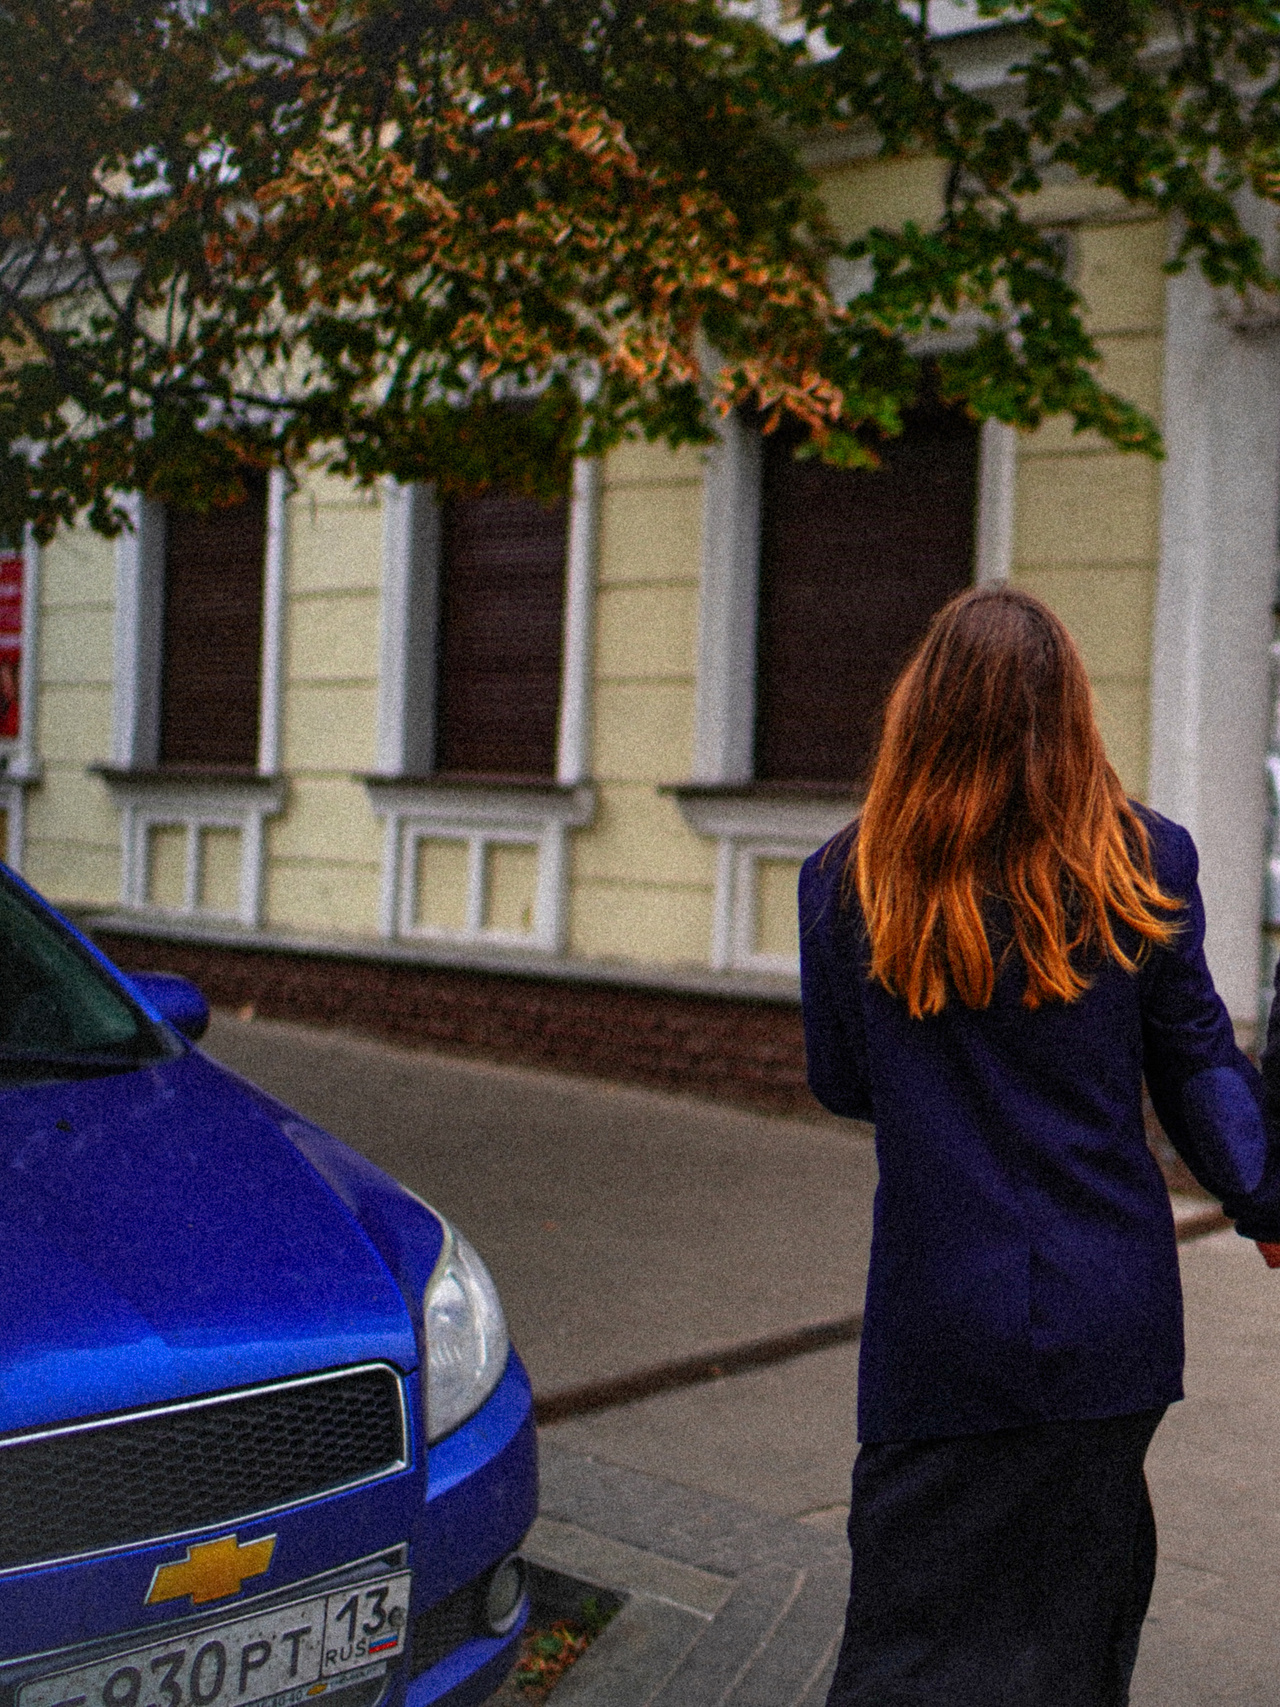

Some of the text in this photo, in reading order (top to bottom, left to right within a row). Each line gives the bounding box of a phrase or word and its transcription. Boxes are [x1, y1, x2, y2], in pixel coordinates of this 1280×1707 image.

[50, 1585, 391, 1707] 930РТ 13
[324, 1639, 368, 1668] RUS
